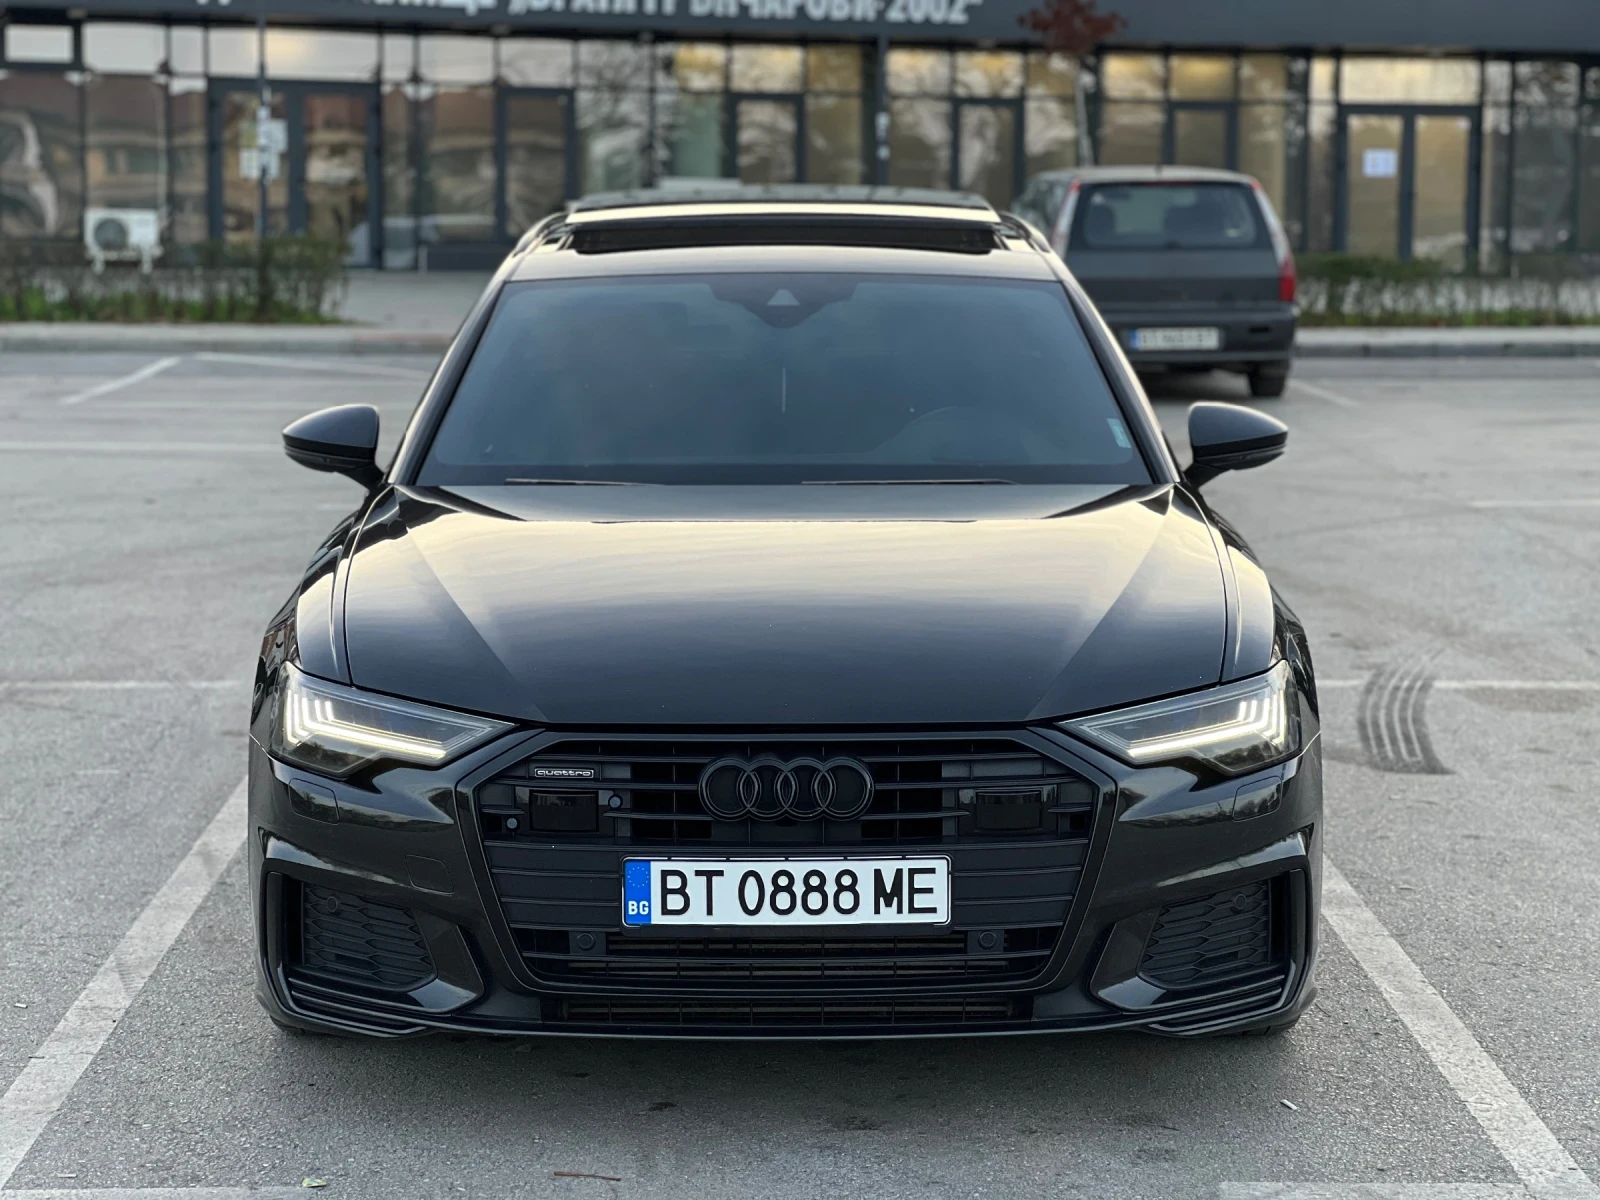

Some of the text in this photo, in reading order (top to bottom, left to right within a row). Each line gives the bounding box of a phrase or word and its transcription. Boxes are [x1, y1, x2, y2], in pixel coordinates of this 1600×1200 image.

[537, 769, 591, 777] quattro
[660, 867, 938, 916] BT 0888 ME
[628, 901, 649, 915] BG
